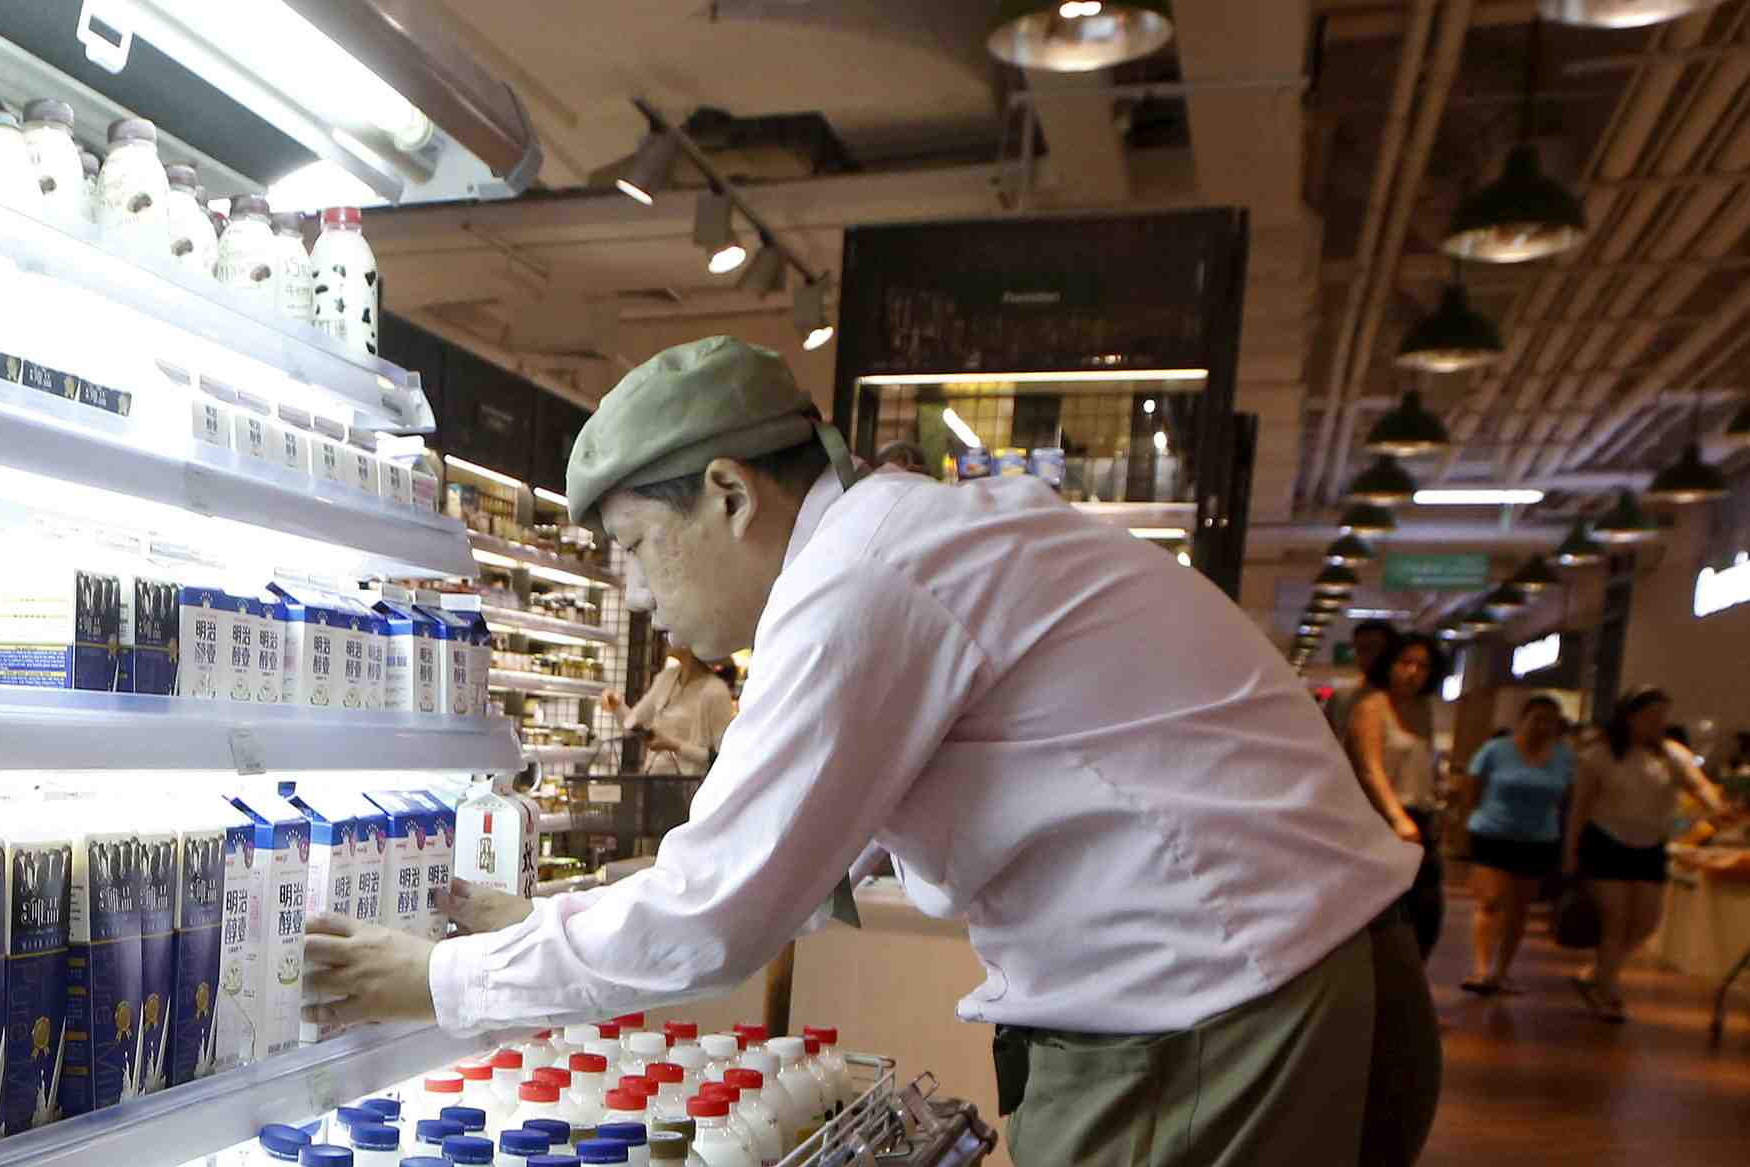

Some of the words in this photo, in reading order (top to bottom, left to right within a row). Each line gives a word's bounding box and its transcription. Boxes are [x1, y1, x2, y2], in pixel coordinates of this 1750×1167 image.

[359, 872, 379, 893] 明治
[400, 867, 420, 888] 明治
[226, 888, 248, 914] 明治
[279, 882, 303, 908] 明治
